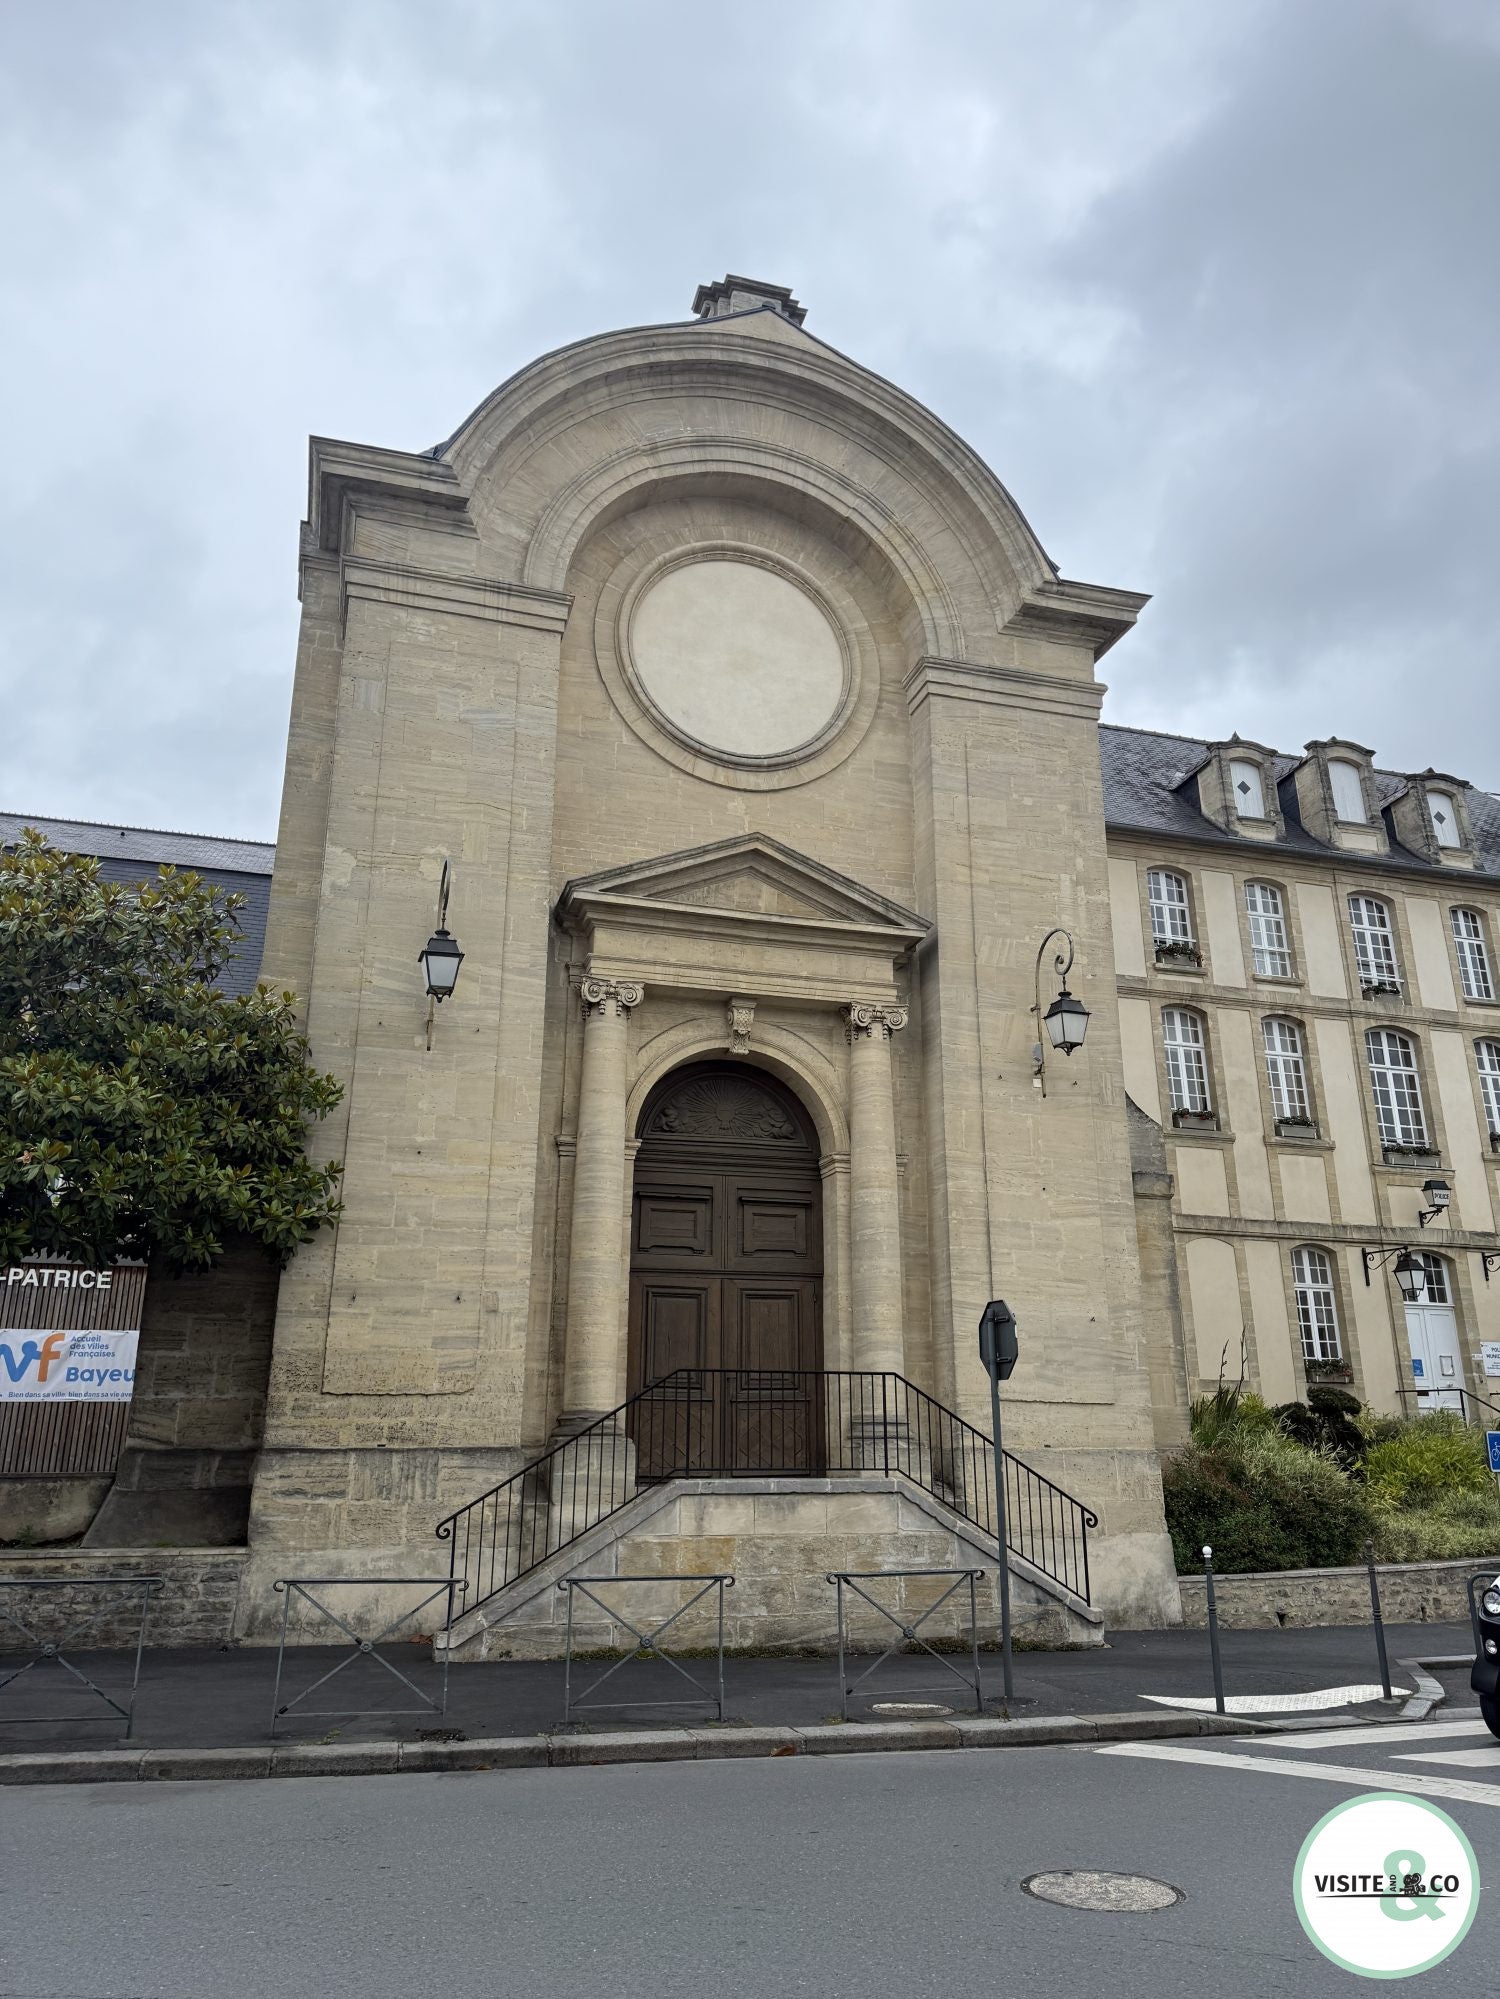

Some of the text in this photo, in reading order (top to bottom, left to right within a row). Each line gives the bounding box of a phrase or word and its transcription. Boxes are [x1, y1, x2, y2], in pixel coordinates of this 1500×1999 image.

[71, 1334, 101, 1343] Accueil
[70, 1342, 86, 1350] des
[69, 1350, 116, 1359] Françaises
